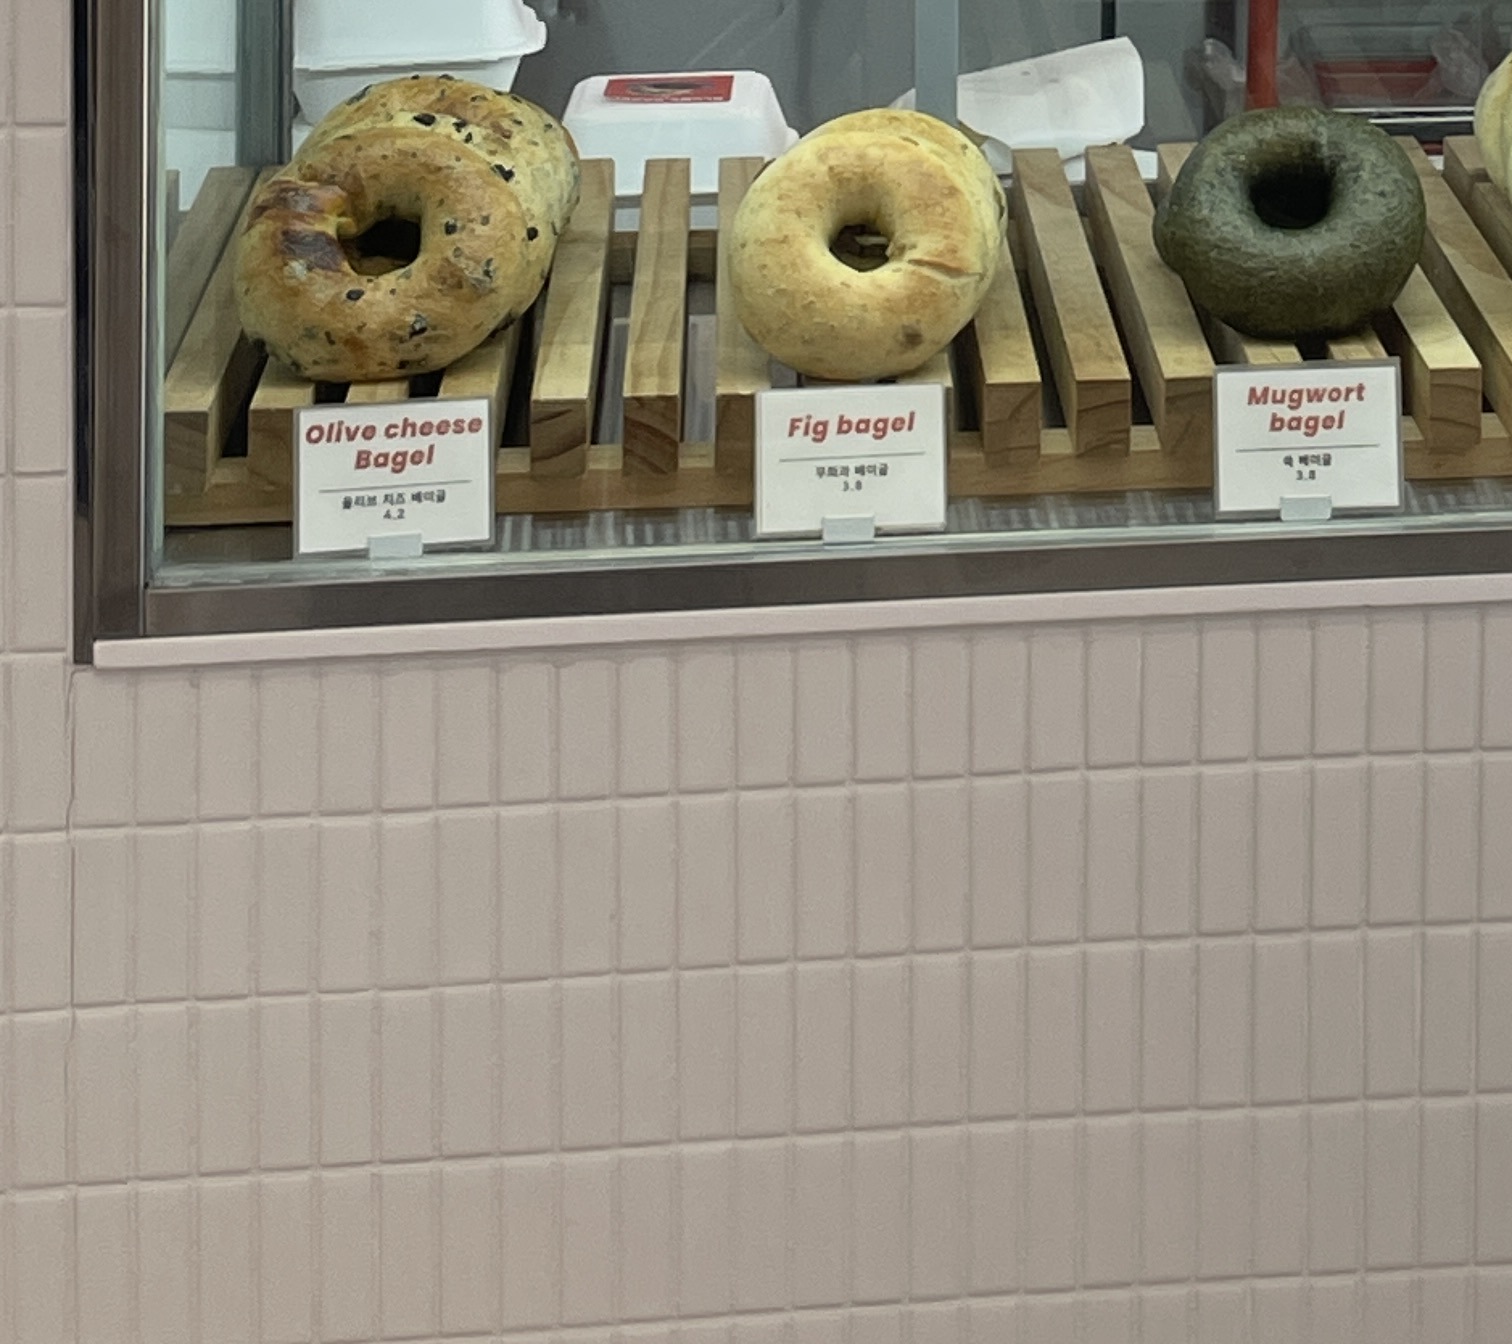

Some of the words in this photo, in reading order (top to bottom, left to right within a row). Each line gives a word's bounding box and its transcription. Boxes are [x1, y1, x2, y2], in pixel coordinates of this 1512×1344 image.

[1247, 383, 1365, 410] Mugwort
[306, 421, 376, 444] Olive
[384, 417, 482, 438] cheese
[788, 415, 829, 443] Fig
[837, 411, 915, 440] bagel
[1269, 410, 1345, 437] bagel
[354, 444, 435, 473] Bagel
